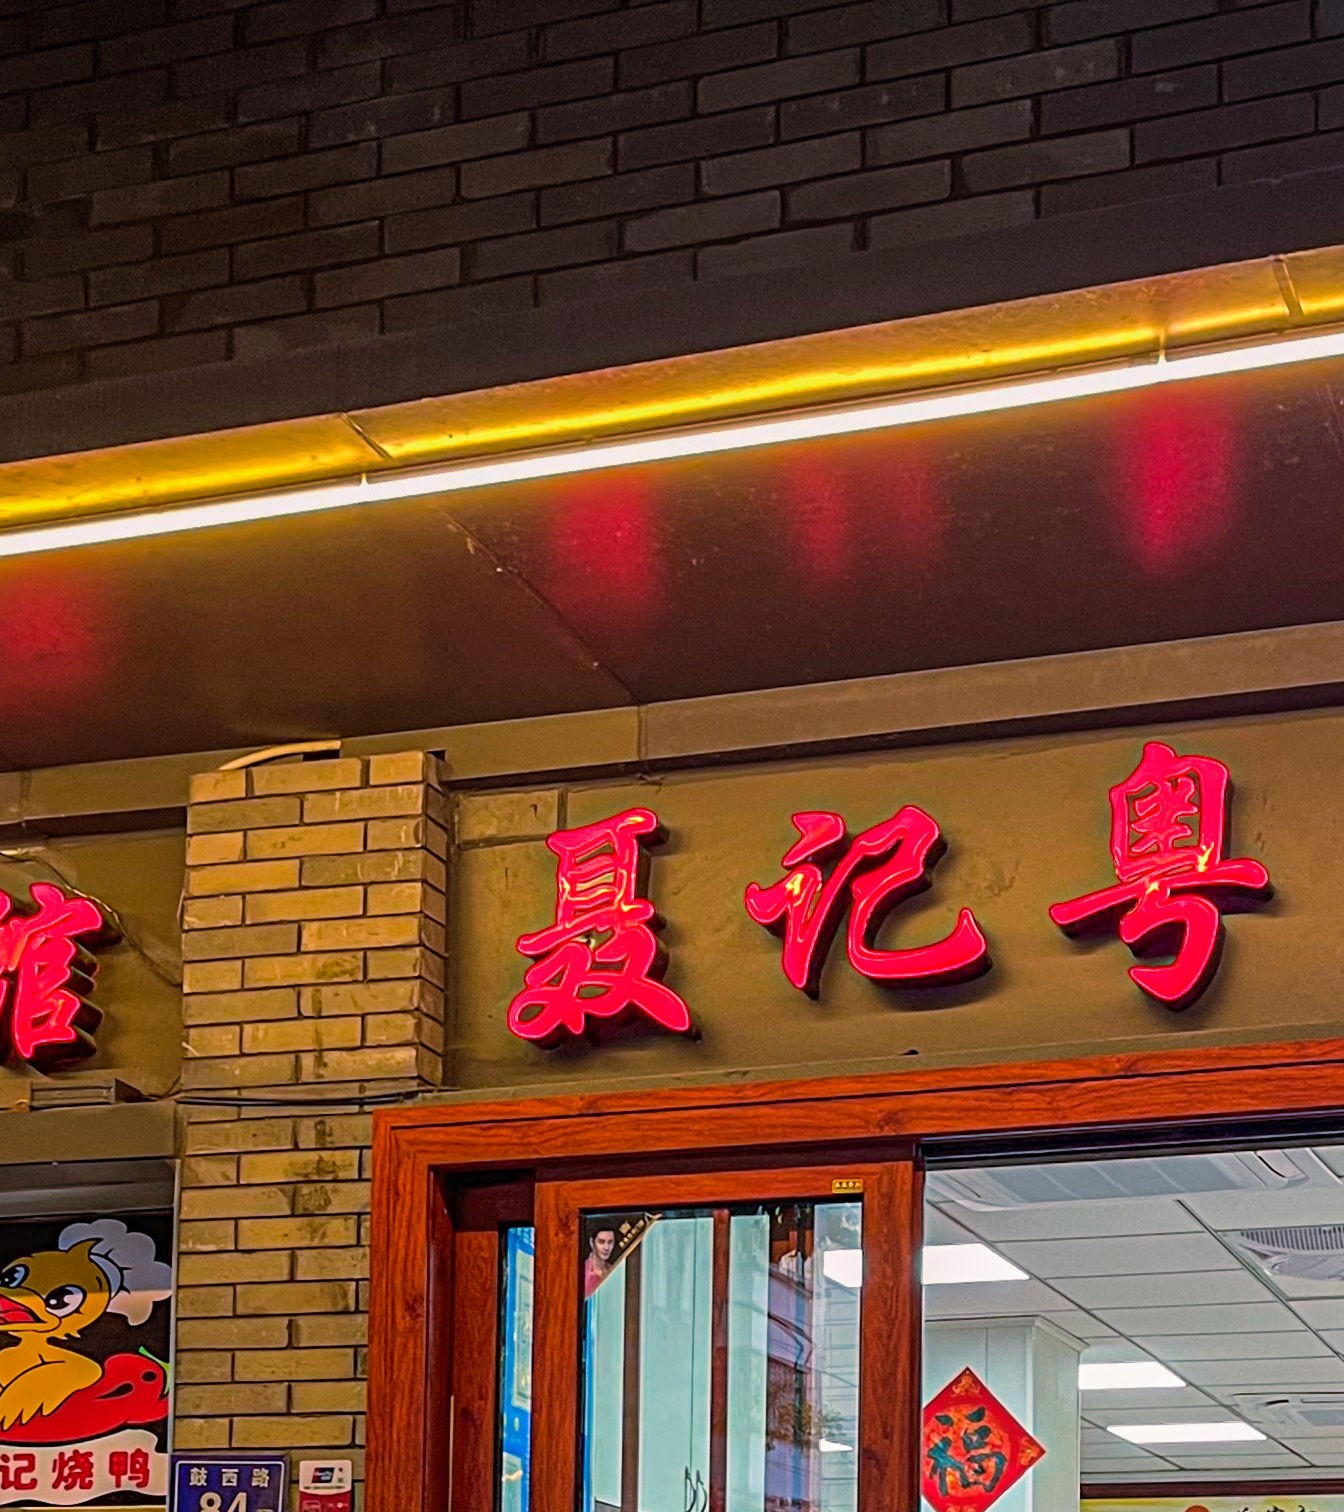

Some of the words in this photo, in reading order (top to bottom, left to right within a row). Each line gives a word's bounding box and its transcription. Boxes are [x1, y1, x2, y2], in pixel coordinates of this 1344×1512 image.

[189, 1467, 270, 1488] 鼓西路
[926, 1406, 1008, 1496] 福
